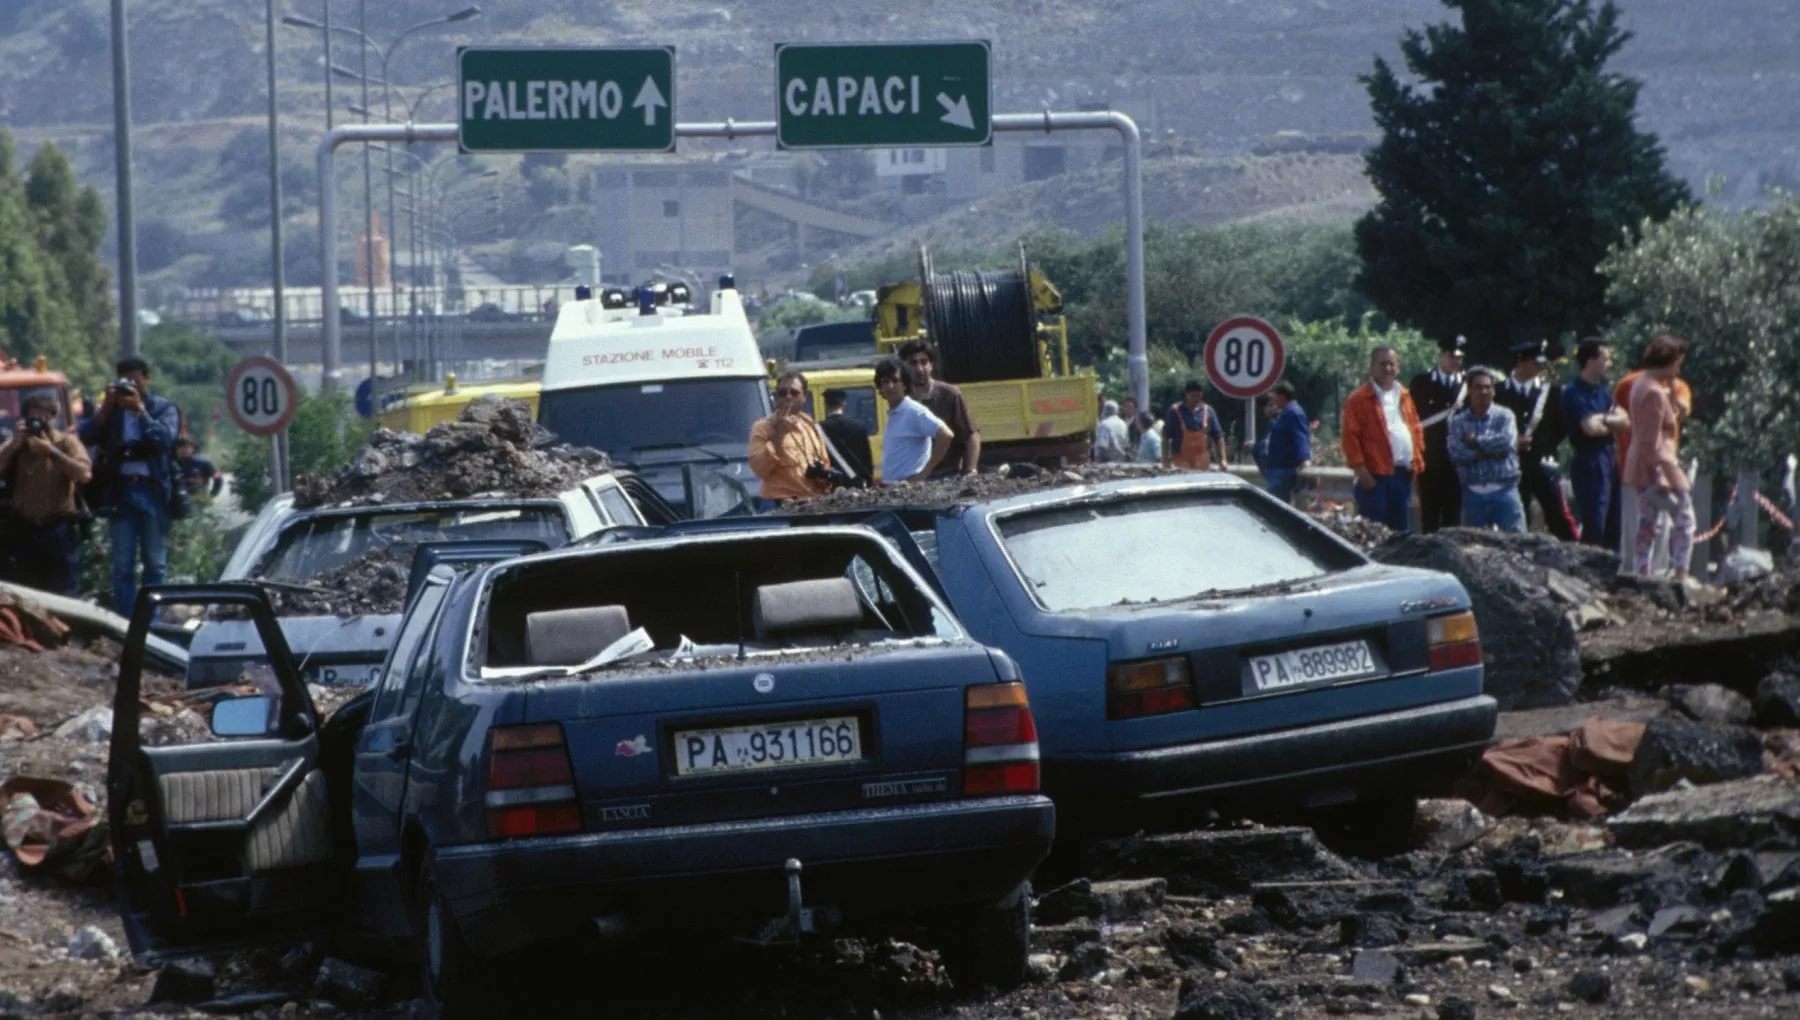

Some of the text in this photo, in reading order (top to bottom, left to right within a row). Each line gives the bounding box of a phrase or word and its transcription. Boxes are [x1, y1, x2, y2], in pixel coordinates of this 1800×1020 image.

[464, 80, 623, 119] PALERMO
[785, 75, 920, 116] CAPACI
[582, 346, 717, 366] STAZIONE MOBILE
[715, 358, 733, 368] 112
[1225, 338, 1265, 377] 80
[243, 376, 279, 416] 80
[1256, 643, 1374, 686] PA 889982
[687, 734, 729, 769] PA
[751, 723, 853, 763] 931166
